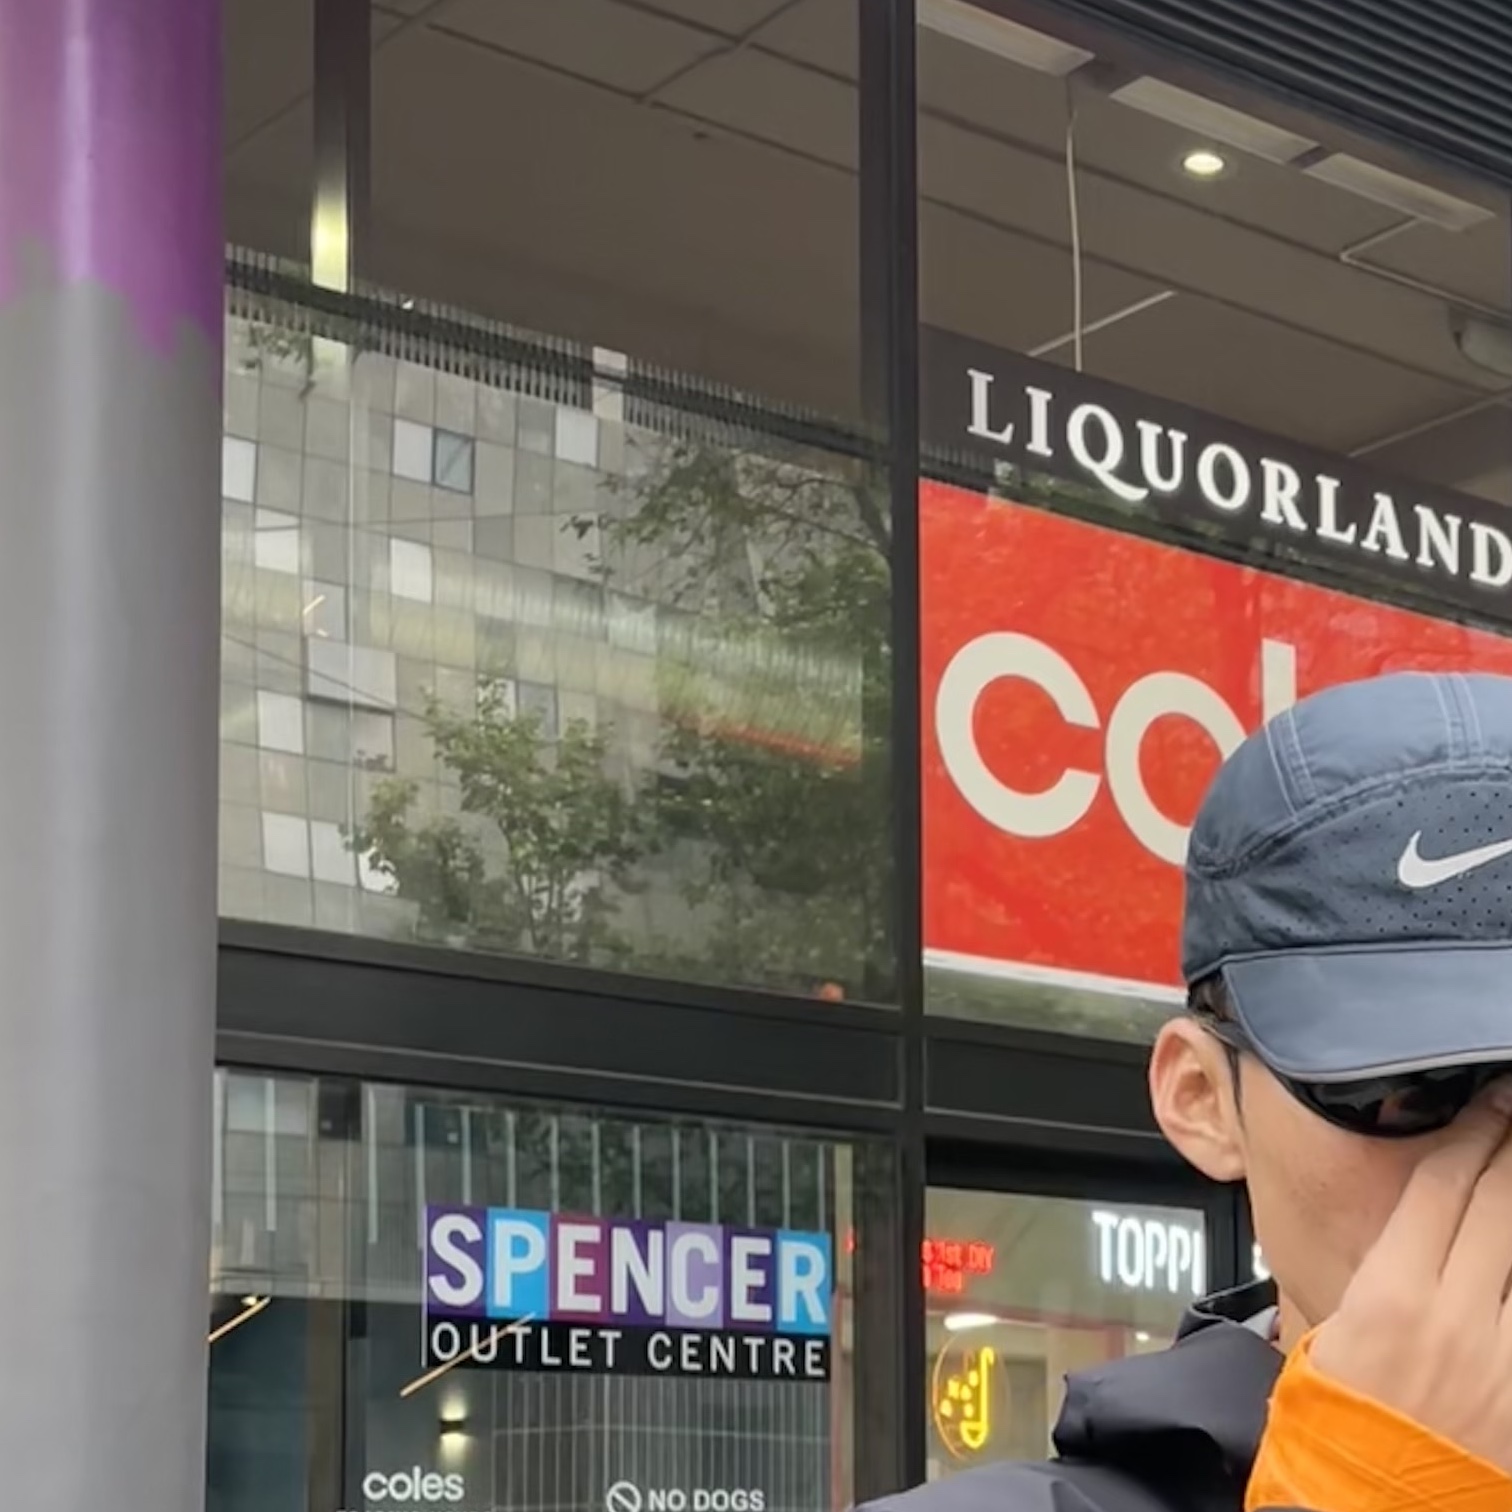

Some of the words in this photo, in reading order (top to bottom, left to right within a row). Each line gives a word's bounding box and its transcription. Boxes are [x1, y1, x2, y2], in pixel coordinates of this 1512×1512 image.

[428, 1213, 828, 1325] SPENCER
[431, 1321, 622, 1368] OUTLET
[647, 1333, 826, 1376] CENTRE
[362, 1465, 465, 1501] coles
[649, 1489, 687, 1512] NO
[693, 1489, 766, 1512] DOGS
